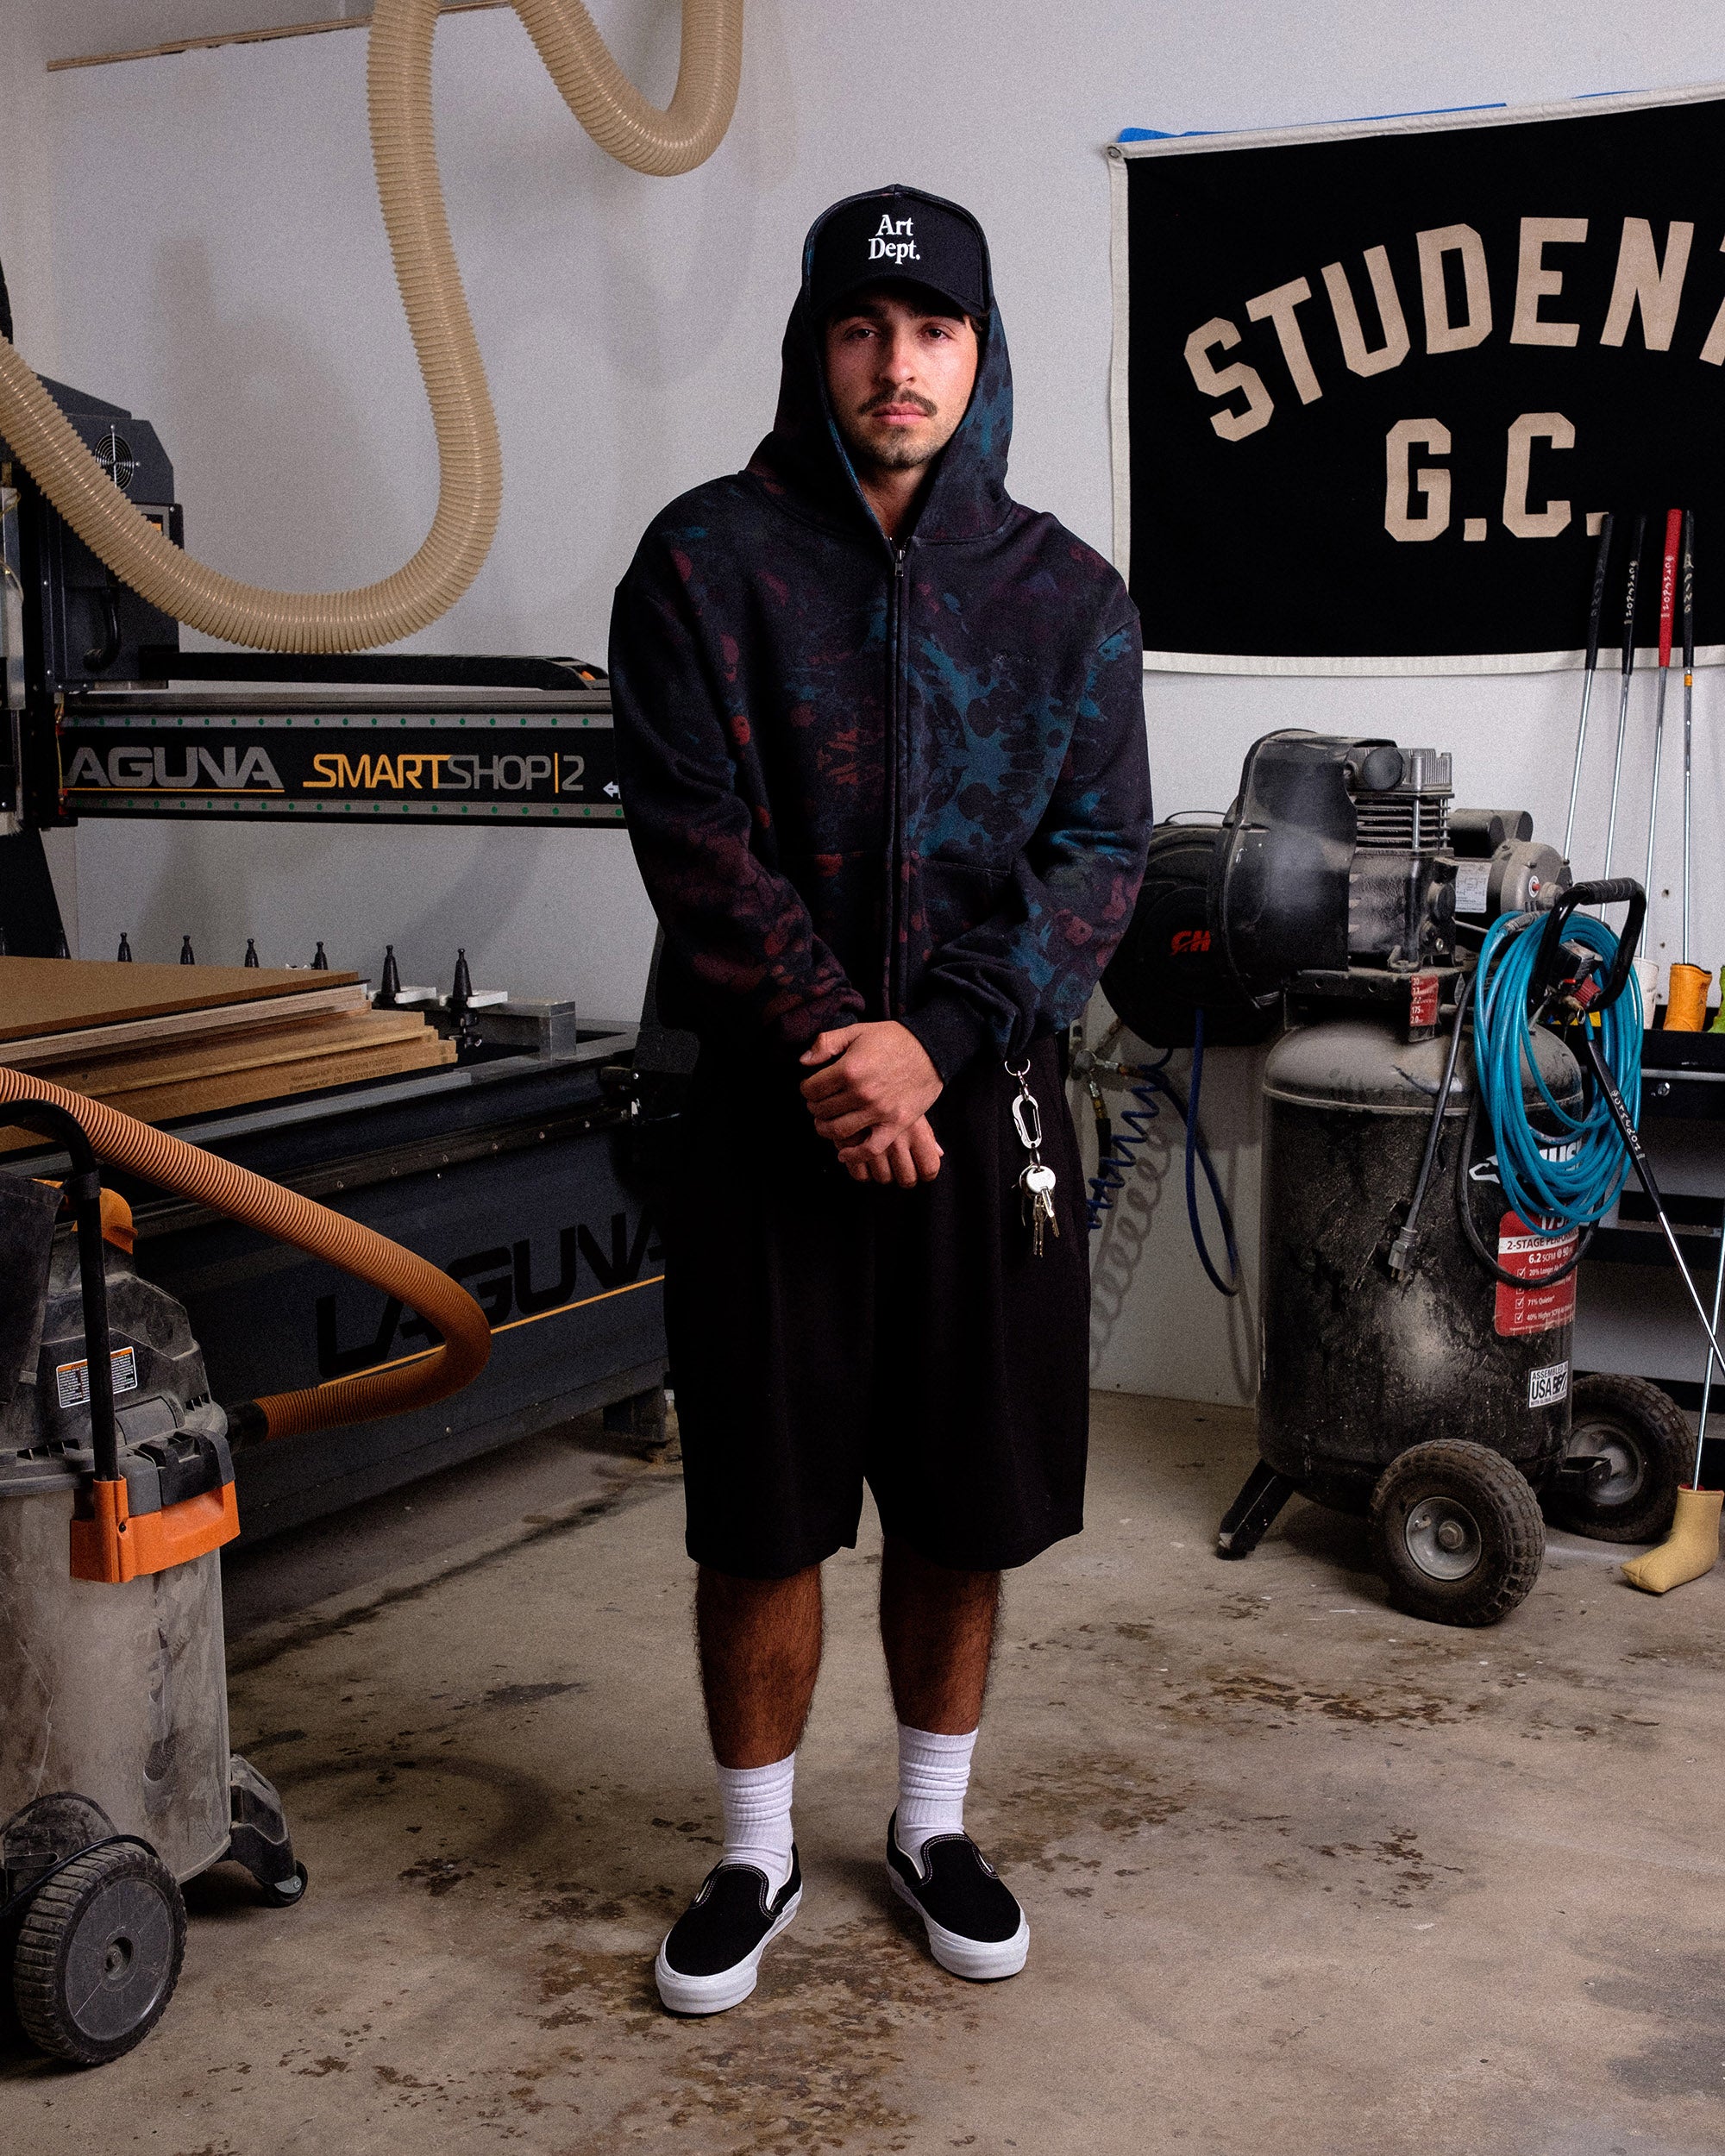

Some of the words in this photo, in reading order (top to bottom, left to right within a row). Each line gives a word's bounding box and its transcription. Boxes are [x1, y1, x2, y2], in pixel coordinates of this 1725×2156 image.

[875, 214, 914, 236] Art
[868, 237, 921, 265] Dept.
[1184, 216, 1725, 442] STUDEN
[1384, 411, 1609, 542] G.C.
[1684, 573, 1693, 613] PING
[63, 746, 285, 789] AGUNA
[1507, 1236, 1545, 1250] 2-STAGE
[1528, 1252, 1541, 1264] 6.2
[1532, 1364, 1564, 1381] ASSEMBLED
[1531, 1377, 1552, 1400] USA
